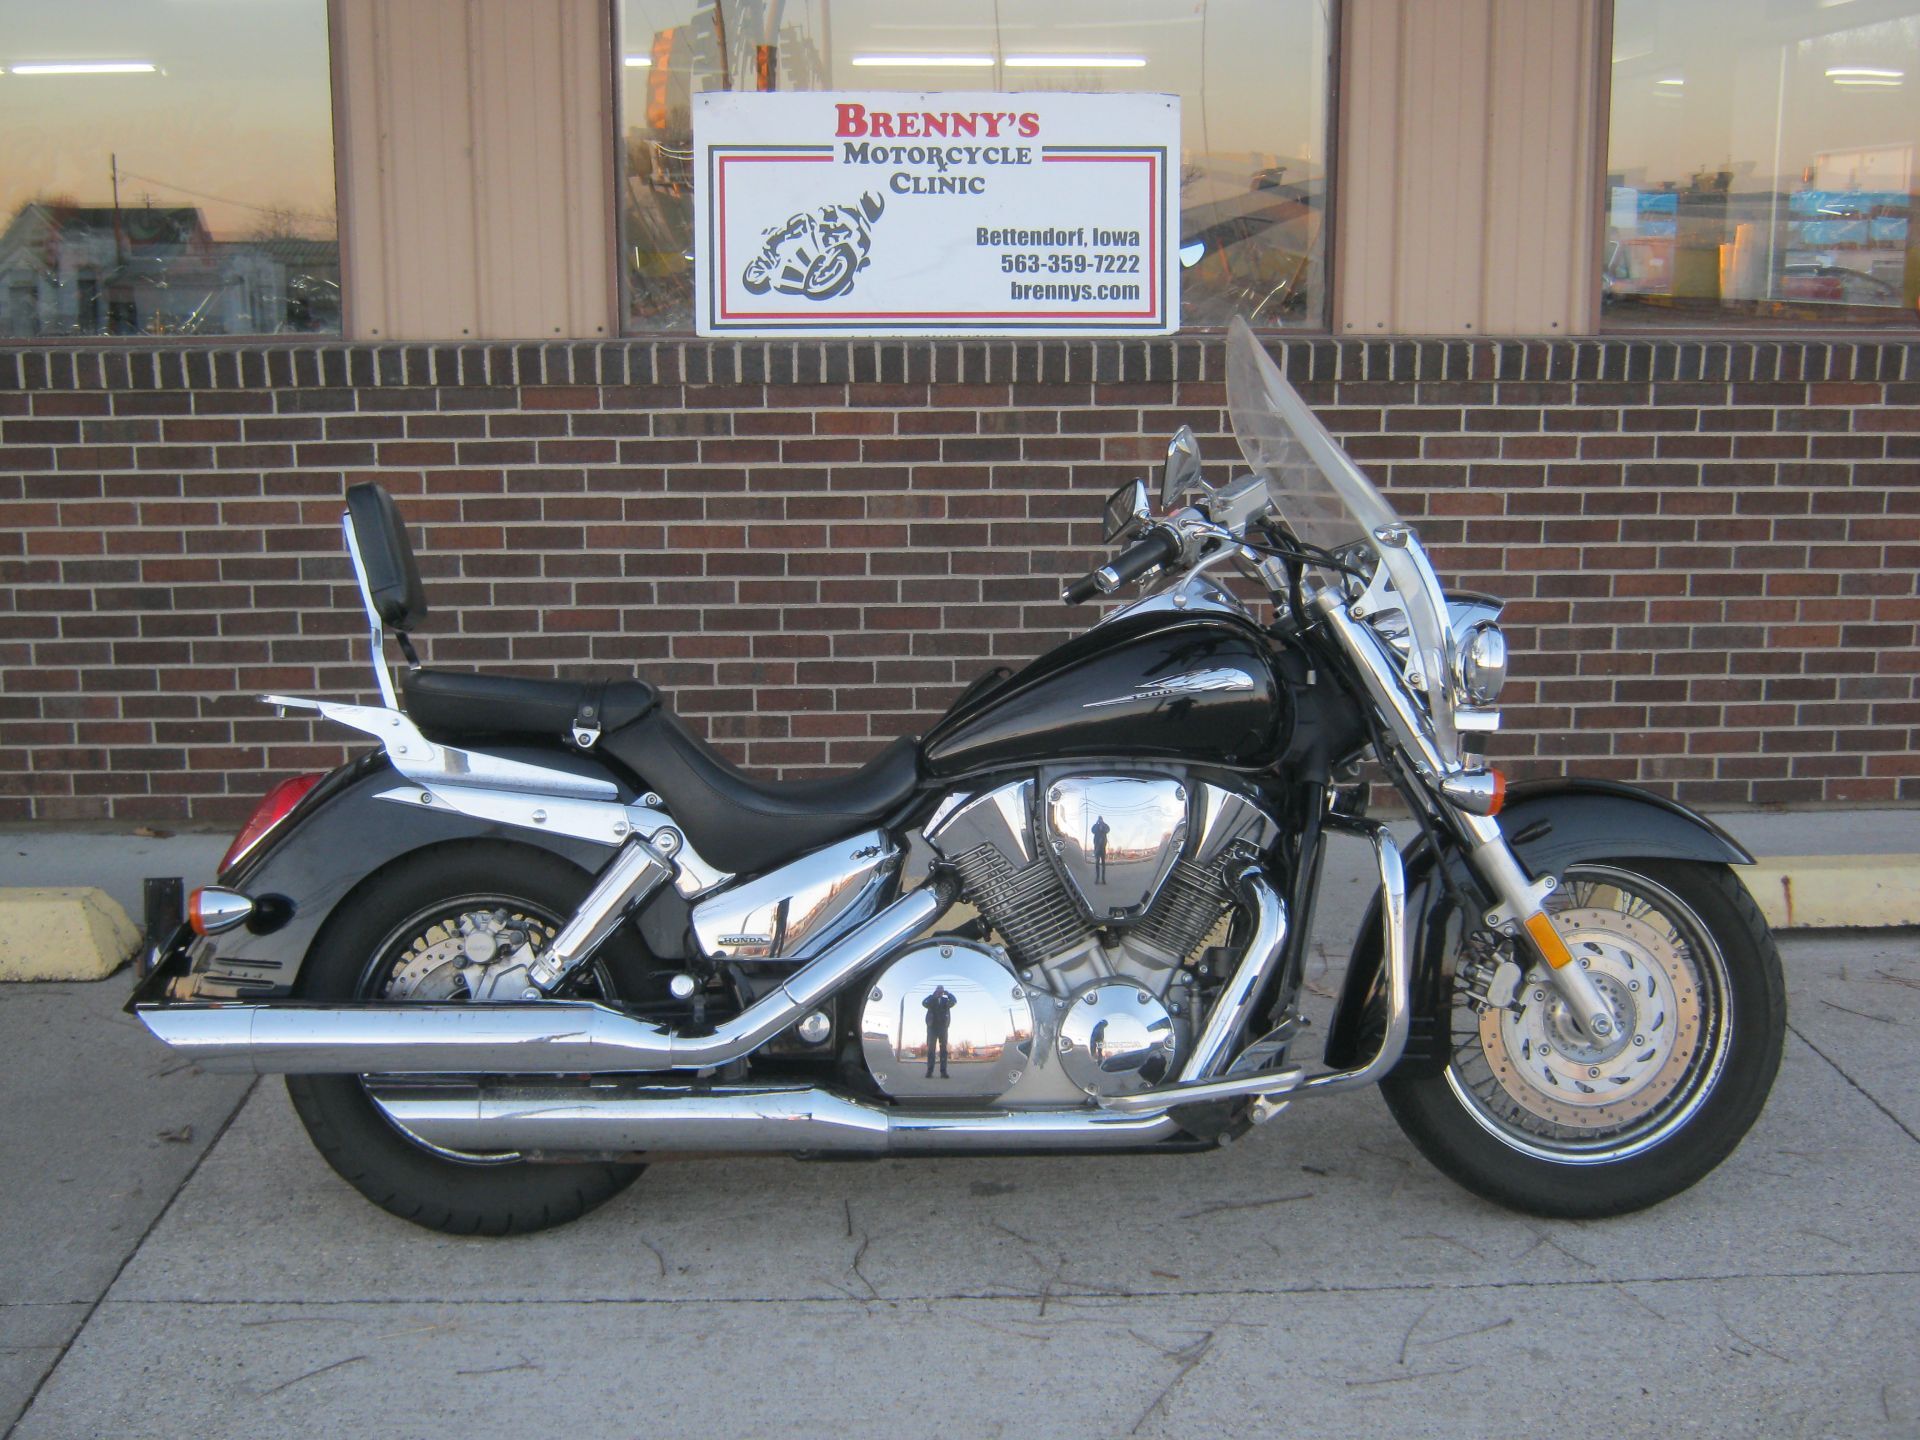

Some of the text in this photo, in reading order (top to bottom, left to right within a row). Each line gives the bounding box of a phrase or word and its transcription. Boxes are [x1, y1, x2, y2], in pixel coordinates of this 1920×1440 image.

[834, 103, 1040, 138] BRENNY'S
[843, 142, 1032, 172] MOTORCYCLE
[889, 172, 986, 194] CLINIC
[976, 227, 1140, 248] Bettendorf, Iowa
[1001, 254, 1140, 273] 563-359-7222
[1011, 281, 1140, 302] brennys.com
[722, 936, 765, 944] HONDA
